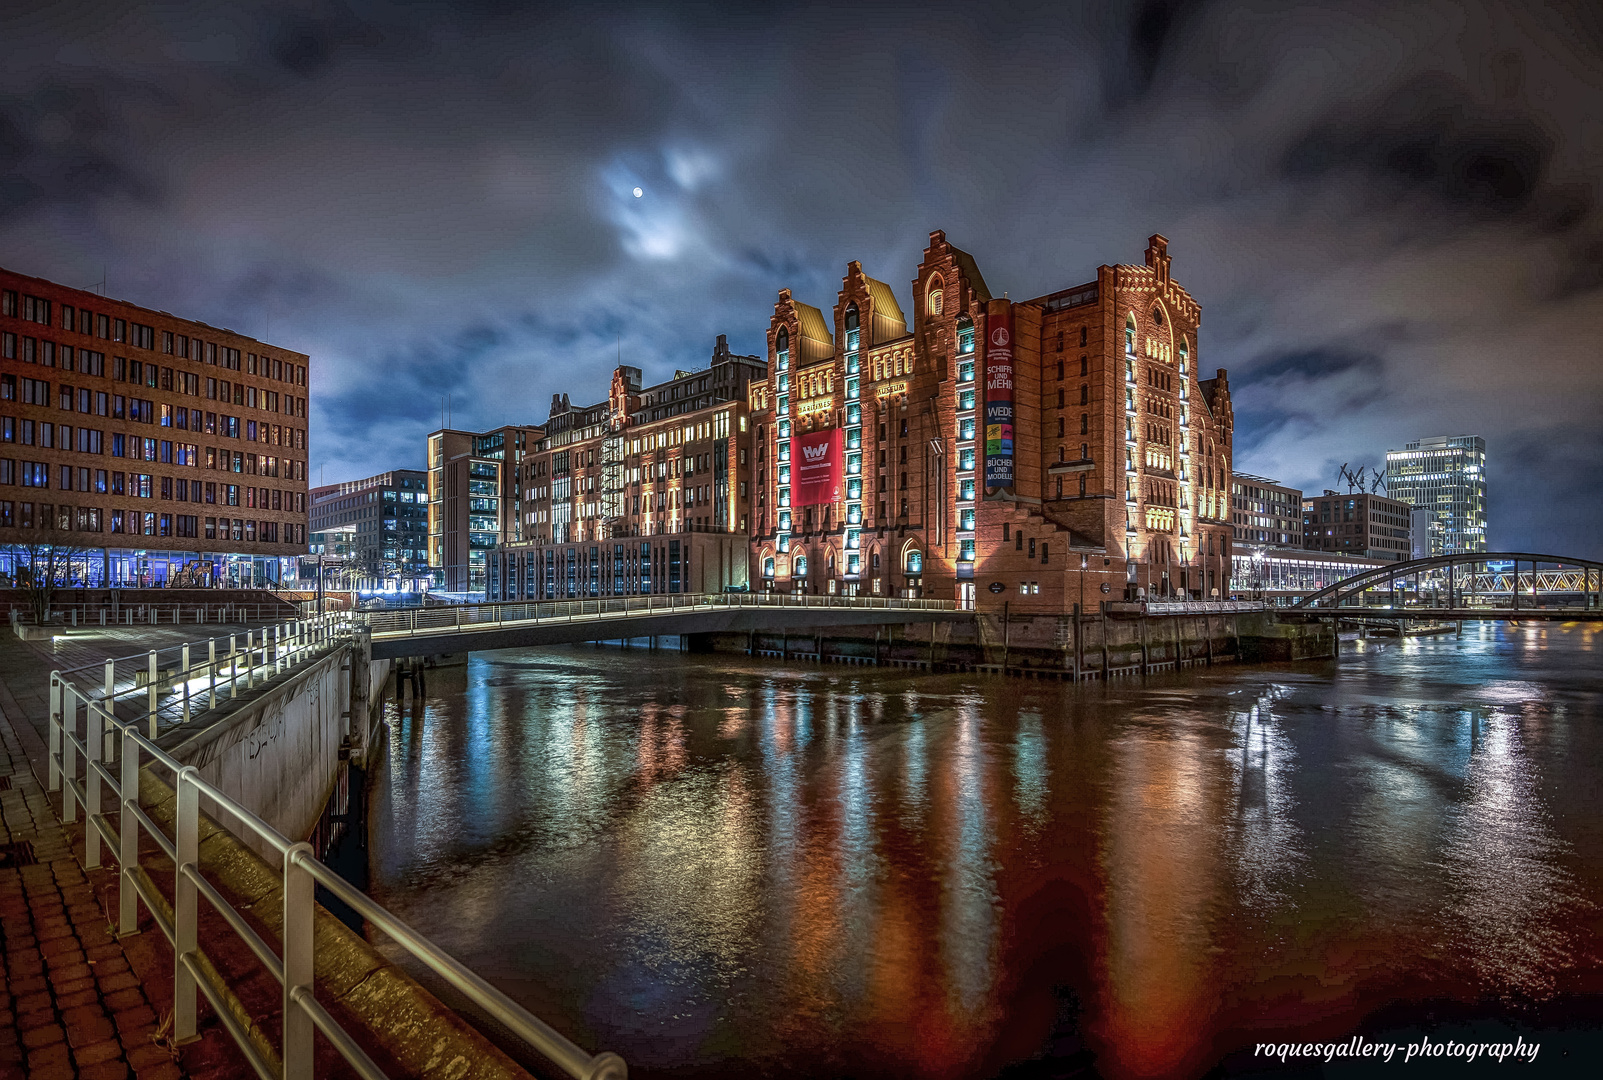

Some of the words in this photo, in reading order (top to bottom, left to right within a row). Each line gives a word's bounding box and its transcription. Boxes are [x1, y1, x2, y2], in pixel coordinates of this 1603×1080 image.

[987, 365, 1013, 374] SCHIFFE
[876, 383, 905, 396] MUSEUM
[987, 379, 1013, 390] MEHR
[987, 406, 1012, 417] WEDE
[987, 457, 1013, 467] BÜCHER
